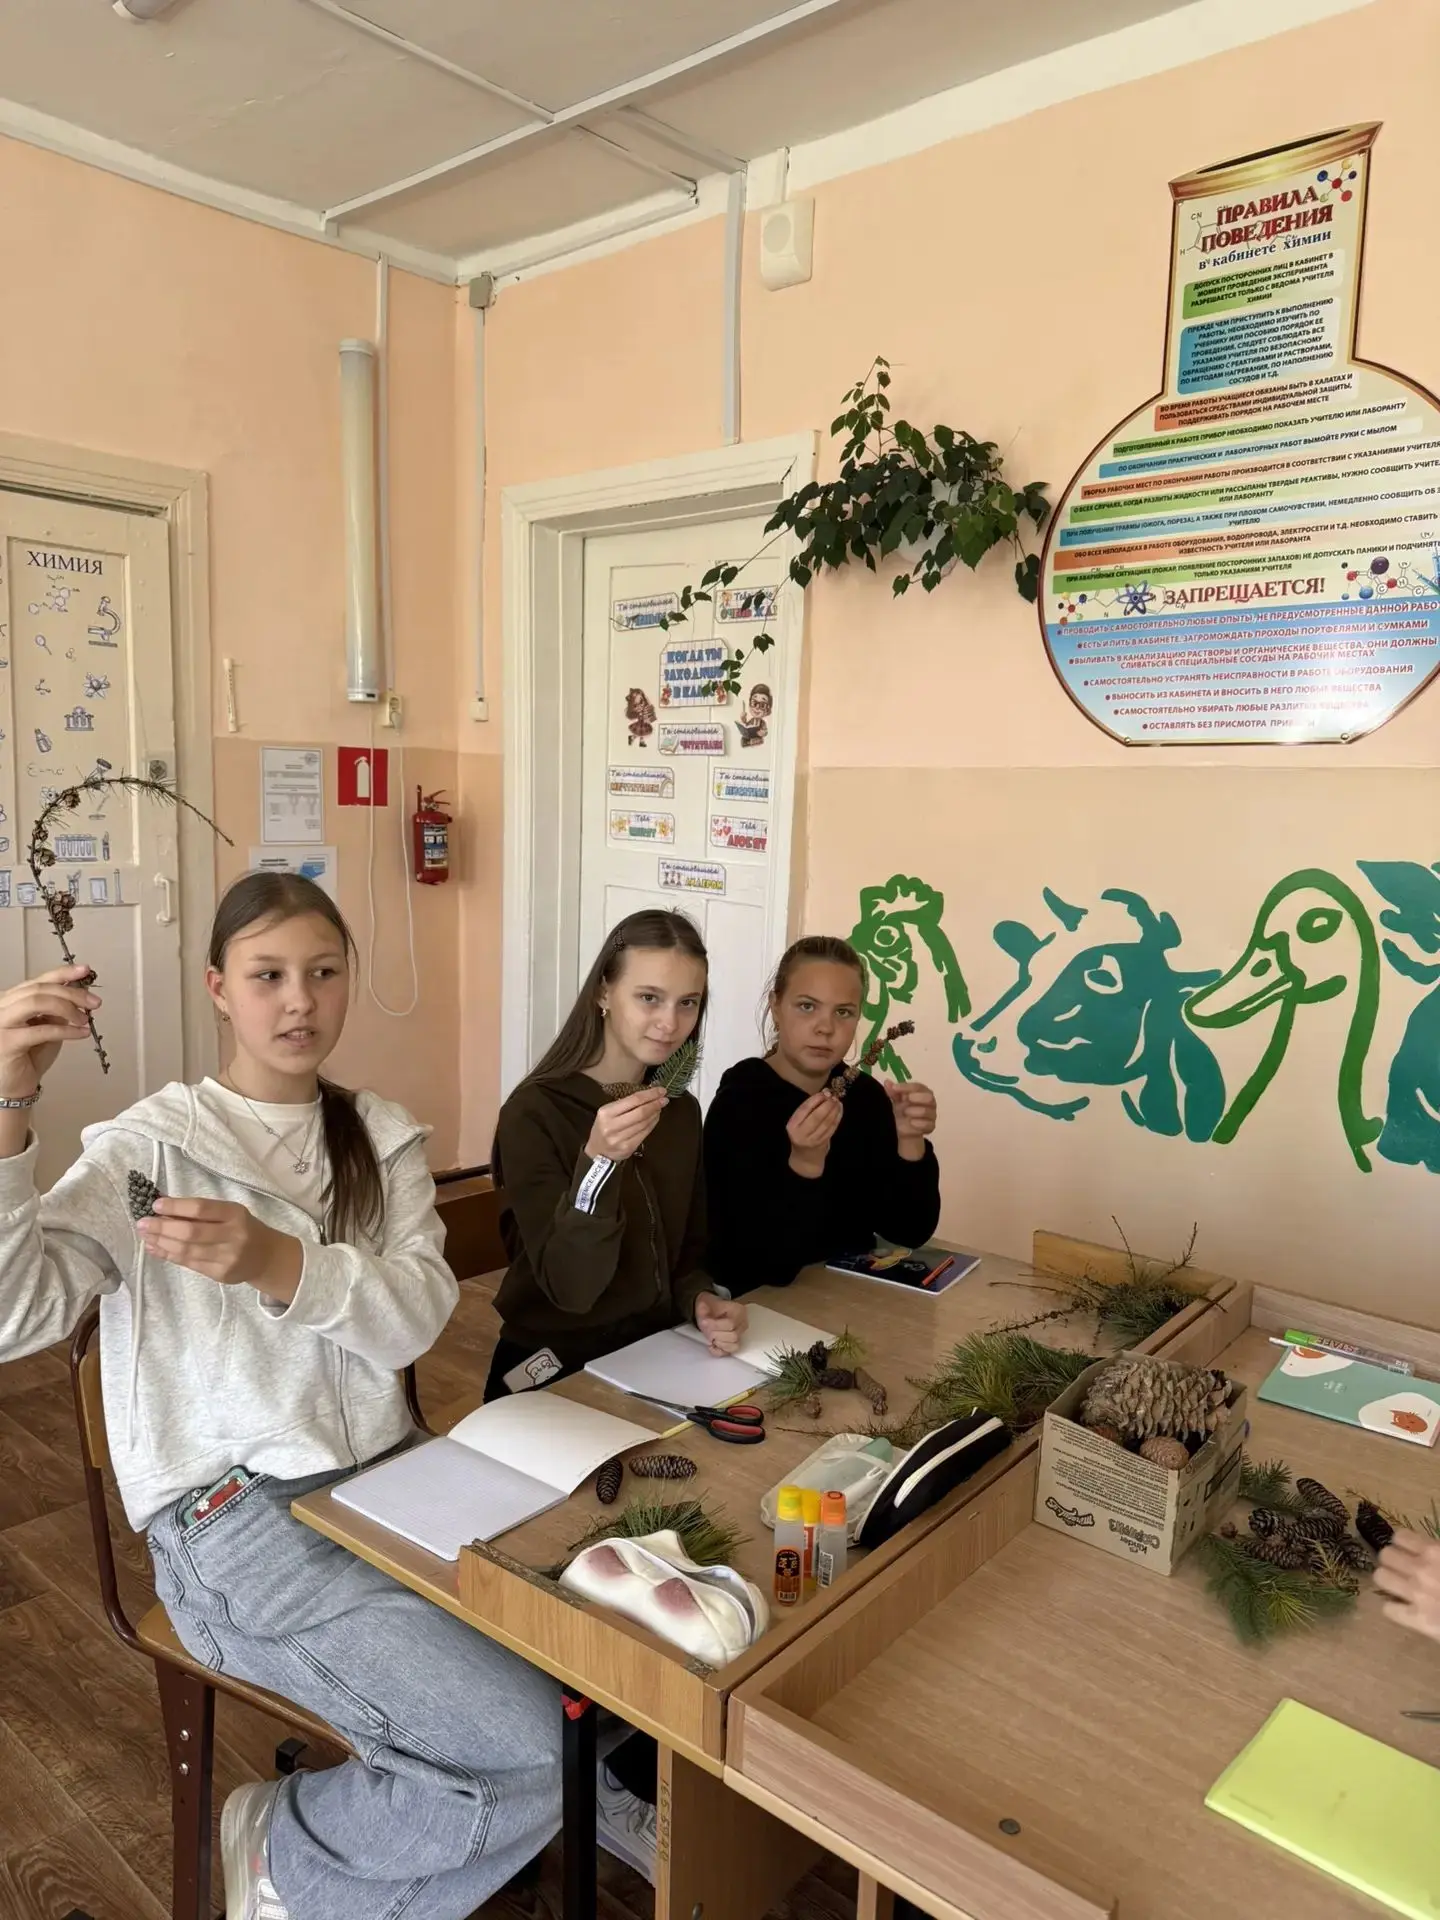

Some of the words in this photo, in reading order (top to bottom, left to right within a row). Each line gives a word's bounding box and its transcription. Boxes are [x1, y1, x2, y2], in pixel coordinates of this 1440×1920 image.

[1217, 186, 1318, 226] ПРАВИЛА
[1201, 204, 1334, 252] ПОВЕДЕНИЯ
[1199, 260, 1206, 270] в
[1213, 244, 1276, 266] кабинете
[1284, 231, 1331, 250] химии
[1191, 291, 1236, 307] РАЗРЕШАЕТСЯ
[1238, 285, 1264, 297] ТОЛЬКО
[1271, 278, 1300, 290] ВЕДОМА
[1302, 270, 1334, 283] УЧИТЕЛЯ
[1194, 278, 1220, 291] ДОПУСК
[1222, 267, 1272, 284] ПОСТОРОННИХ
[1273, 263, 1288, 272] ЛИЦ
[1295, 254, 1328, 267] КАБИНЕТ
[1198, 285, 1226, 297] МОМЕНТ
[1227, 275, 1272, 291] ПРОВЕДЕНИЯ
[1273, 263, 1328, 281] ЭКСПЕРИМЕНТА
[1247, 292, 1272, 304] ХИМИИ
[1188, 322, 1214, 334] ПРЕЖДЕ
[1215, 319, 1229, 328] ЧЕМ
[1230, 310, 1274, 325] ПРИСТУПИТЬ
[1281, 298, 1333, 314] ВЫПОЛНЕНИЮ
[1191, 343, 1236, 358] ПРОВЕДЕНИЯ.
[1237, 338, 1266, 349] СЛЕДУЕТ
[1268, 329, 1310, 343] СОБЛЮДАТЬ
[1312, 326, 1325, 335] ВСЕ
[1194, 336, 1227, 349] УЧЕБНИКУ
[1229, 333, 1243, 342] ИЛИ
[1245, 326, 1279, 339] ПОСОБИЮ
[1280, 319, 1314, 332] ПОРЯДОК
[1193, 354, 1226, 367] УКАЗАНИЯ
[1228, 348, 1258, 360] УЧИТЕЛЯ
[1259, 345, 1268, 354] ПО
[1270, 335, 1322, 351] БЕЗОПАСНОМУ
[1160, 406, 1207, 420] ПОЛЬЗОВАТЬСЯ
[1209, 399, 1251, 412] СРЕДСТВАМИ
[1253, 387, 1318, 405] ИНДИВИДУАЛЬНОЙ
[1319, 382, 1352, 394] ЗАЩИТЫ,
[1170, 401, 1190, 410] ВРЕМЯ
[1192, 396, 1217, 407] РАБОТЫ
[1219, 390, 1254, 402] УЧАЩИЕСЯ
[1256, 384, 1288, 396] ОБЯЗАНЫ
[1289, 380, 1308, 390] БЫТЬ
[1315, 374, 1346, 386] ХАЛАТАХ
[1179, 411, 1229, 426] ПОДДЕРЖИВАТЬ
[1231, 406, 1261, 417] ПОРЯДОК
[1274, 399, 1305, 410] РАБОЧЕМ
[1307, 395, 1329, 405] МЕСТЕ
[1113, 438, 1170, 454] ПОДГОТОВЛЕННЫЙ
[1177, 434, 1199, 444] РАБОТЕ
[1201, 430, 1226, 440] ПРИБОР
[1227, 422, 1272, 436] НЕОБХОДИМО
[1274, 417, 1309, 428] ПОКАЗАТЬ
[1310, 411, 1344, 423] УЧИТЕЛЮ
[1346, 408, 1360, 417] ИЛИ
[1362, 401, 1406, 415] ЛАБОРАНТУ
[1129, 458, 1166, 471] ОКОНЧАНИИ
[1168, 451, 1216, 465] ПРАКТИЧЕСКИХ
[1225, 442, 1278, 456] ЛАБОРАТОРНЫХ
[1280, 439, 1302, 448] РАБОТ
[1303, 432, 1339, 445] ВЫМОЙТЕ
[1340, 430, 1358, 440] РУКИ
[1367, 425, 1397, 436] МЫЛОМ
[27, 550, 103, 575] ХИМИЯ
[1164, 576, 1326, 606] ЗАПРЕЩАЕТСЯ!
[1064, 625, 1109, 635] ПРОВОДИТЬ
[1111, 620, 1185, 632] САМОСТОЯТЕЛЬНО
[1187, 618, 1217, 627] ЛЮБЫЕ
[1220, 615, 1255, 625] ОПЫТЫ,
[1270, 608, 1364, 621] ПРЕДУСМОТРЕННЫЕ
[1366, 604, 1408, 615] ДАННОЙ
[1411, 603, 1440, 612] РАБО
[1083, 640, 1101, 649] ЕСТЬ
[1109, 639, 1130, 647] ПИТЬ
[1139, 636, 1180, 645] КАБИНЕТЕ,
[1184, 631, 1253, 643] ЗАГРОМОЖДАТЬ
[1255, 629, 1299, 638] ПРОХОДЫ
[1301, 625, 1366, 636] ПОРТФЕЛЯМИ
[1378, 621, 1428, 631] СУМКАМИ
[667, 650, 704, 664] КОГДА
[705, 648, 722, 661] ТЫ
[673, 686, 682, 698] В
[1090, 676, 1163, 686] САМОСТОЯТЕЛЬНО
[1164, 674, 1211, 683] УСТРАНЯТЬ
[1213, 671, 1288, 681] НЕИСПРАВНОСТИ
[1298, 669, 1331, 678] РАБОТЕ
[1112, 692, 1155, 700] ВЫНОСИТЬ
[1169, 690, 1211, 698] КАБИНЕТА
[1221, 688, 1261, 697] ВНОСИТЬ
[1295, 686, 1328, 695] ЛЮБЫЕ
[1332, 685, 1382, 694] ВЕЩЕСТВА
[1214, 720, 1267, 728] ПРИСМОТРА
[727, 834, 767, 850] ЛЮБЯТ
